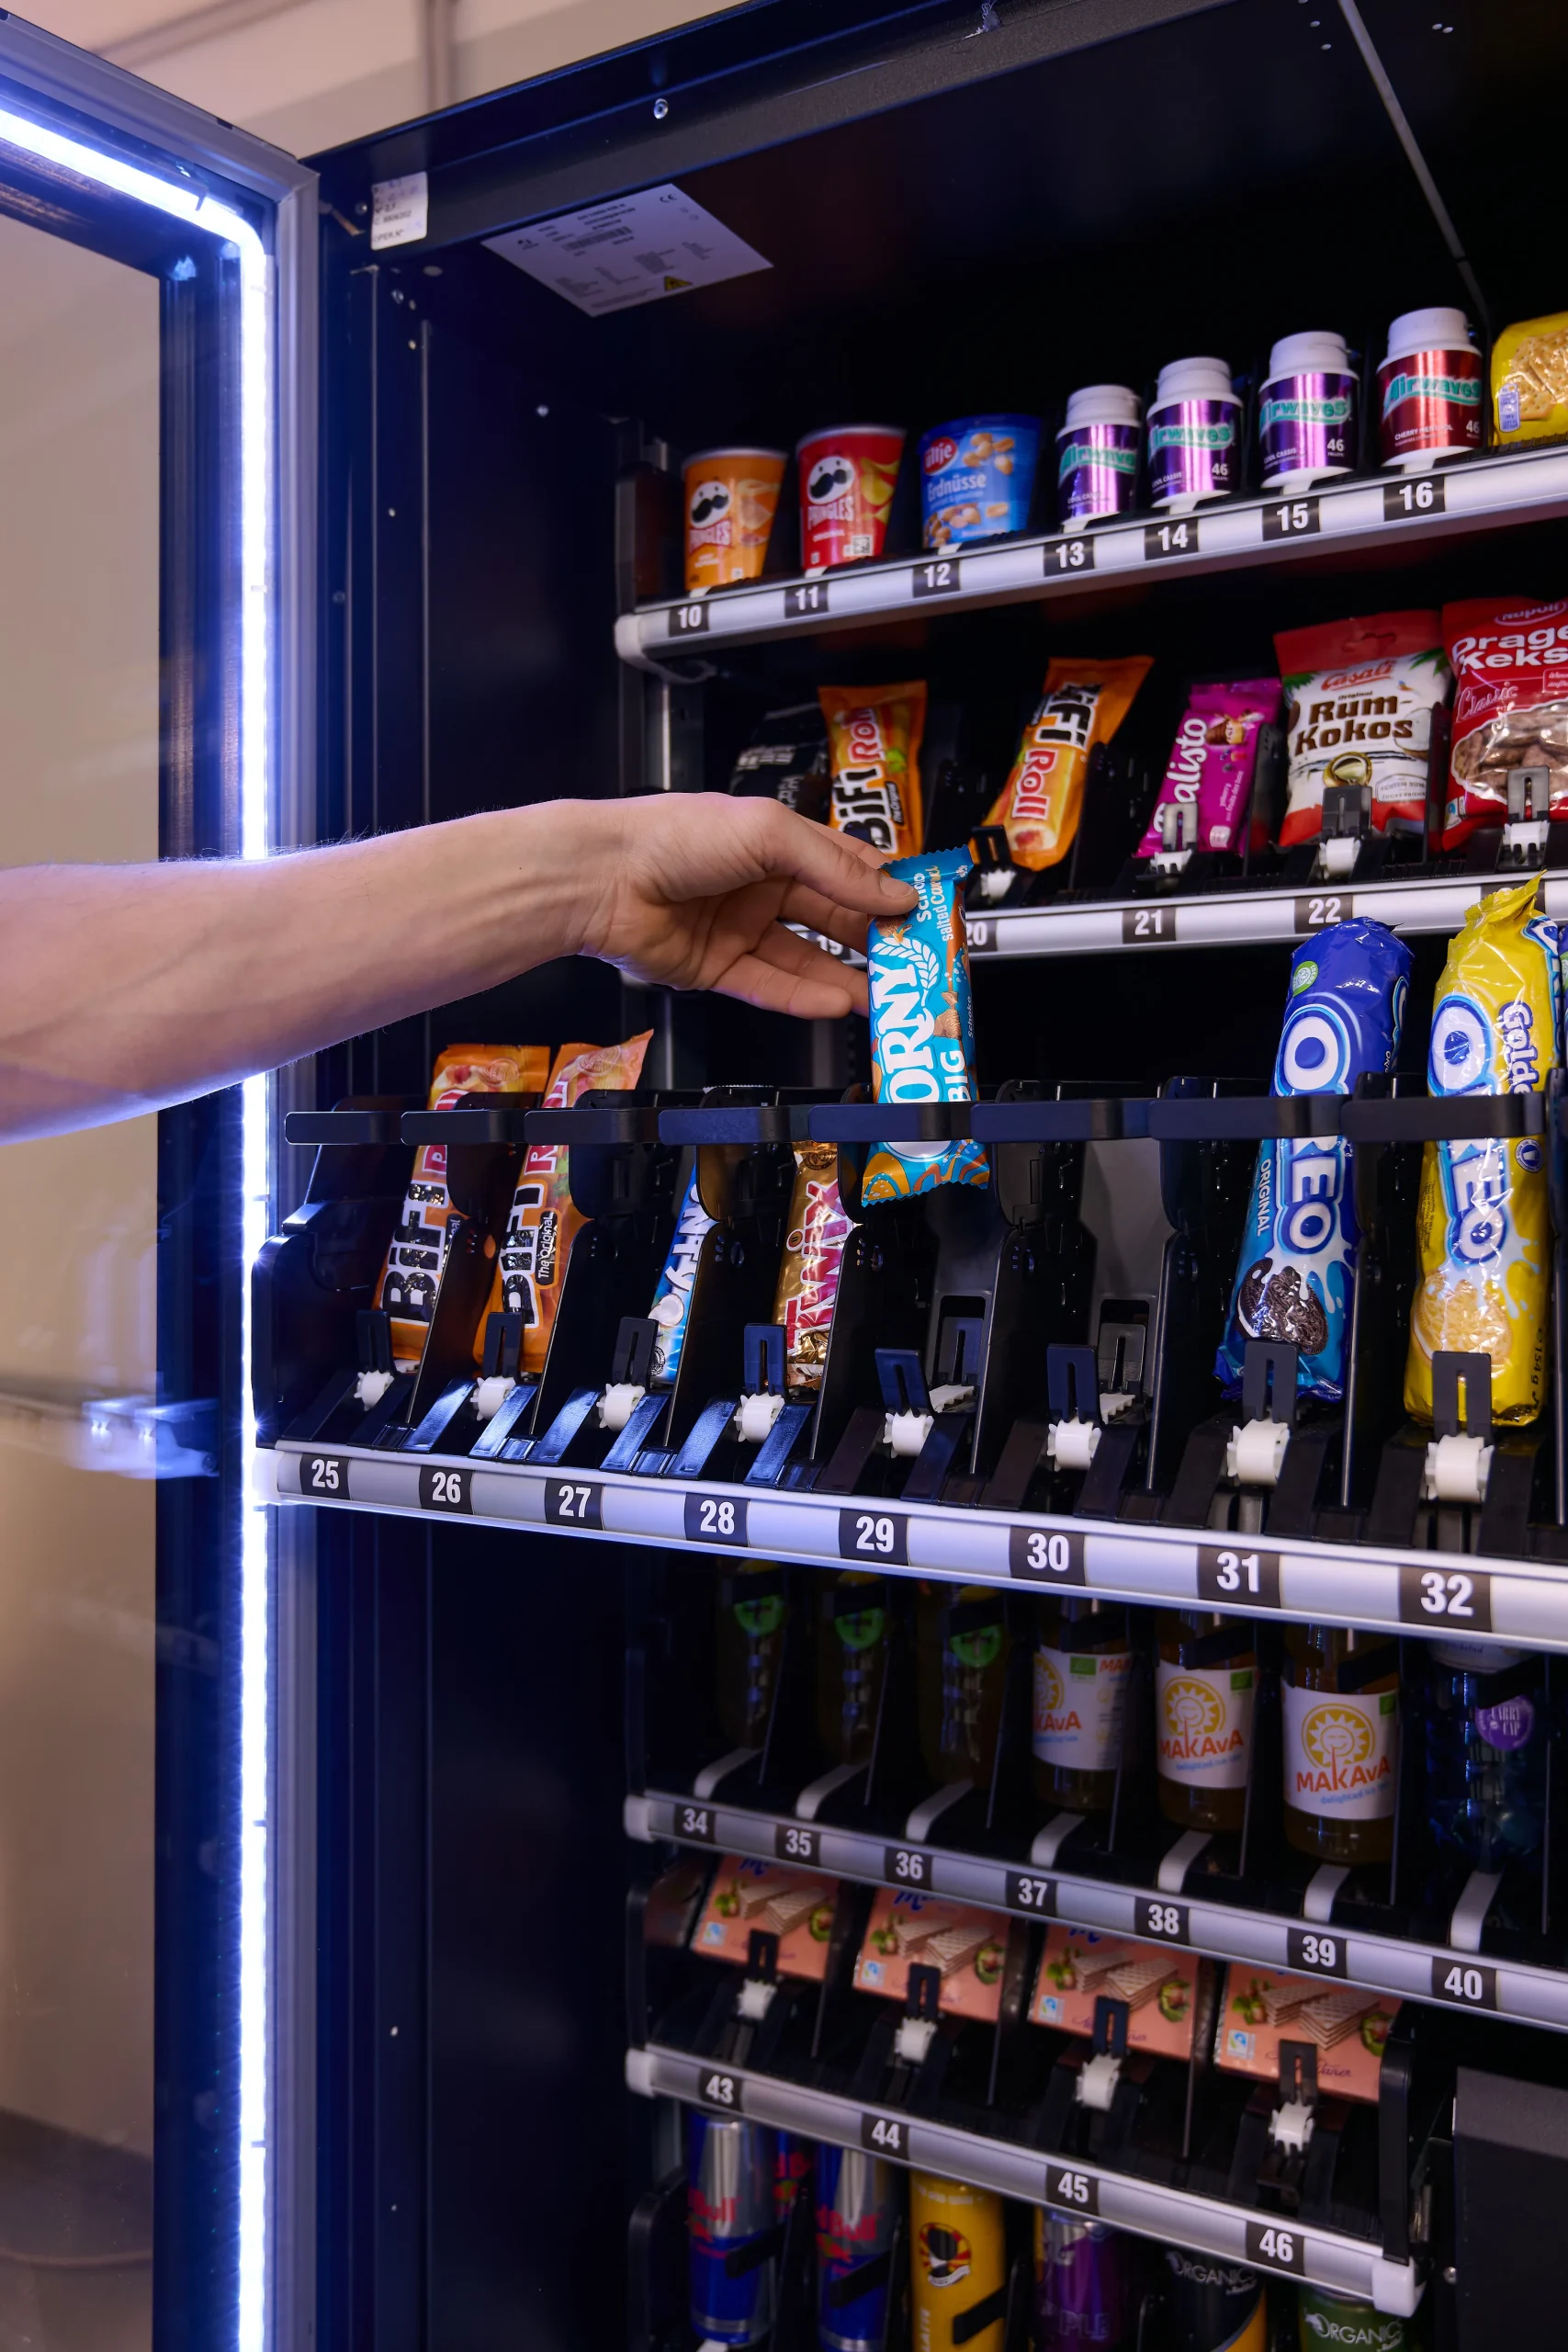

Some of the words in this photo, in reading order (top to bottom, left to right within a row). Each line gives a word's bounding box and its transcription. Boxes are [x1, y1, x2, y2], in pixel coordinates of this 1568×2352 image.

[1465, 419, 1480, 435] 46
[1326, 438, 1345, 452] 46
[1058, 442, 1136, 489] Airwave
[1212, 463, 1229, 476] 46
[927, 473, 987, 503] Erdnüsse
[1399, 481, 1434, 511] 16
[1276, 503, 1310, 532] 15
[1157, 523, 1189, 551] 14
[1055, 541, 1085, 569] 13
[923, 562, 951, 588] 12
[795, 585, 819, 611] 11
[677, 605, 703, 628] 10
[1293, 718, 1414, 757] Kokos
[935, 904, 954, 942] salted
[1134, 909, 1164, 935] 21
[1308, 897, 1342, 924] 22
[868, 959, 942, 1132] ORNY
[1498, 1001, 1540, 1094] Golde
[940, 1049, 972, 1102] BIG
[1257, 1158, 1272, 1238] ORIGINAL
[541, 1211, 558, 1259] Original
[1532, 1345, 1544, 1374] 154
[311, 1458, 340, 1489] 25
[432, 1471, 462, 1504] 26
[558, 1485, 592, 1518] 27
[699, 1499, 735, 1535] 28
[855, 1515, 895, 1553] 29
[1027, 1532, 1070, 1571] 30
[1216, 1551, 1259, 1592] 31
[1420, 1571, 1473, 1616] 32
[682, 1807, 708, 1835] 34
[785, 1828, 812, 1857] 35
[896, 1851, 923, 1880] 36
[1018, 1877, 1048, 1906] 37
[1147, 1904, 1179, 1935] 38
[1302, 1935, 1337, 1967] 39
[1444, 1966, 1483, 2000] 40
[705, 2075, 734, 2104] 43
[871, 2119, 900, 2149] 44
[1057, 2171, 1089, 2203] 45
[1258, 2229, 1293, 2262] 46
